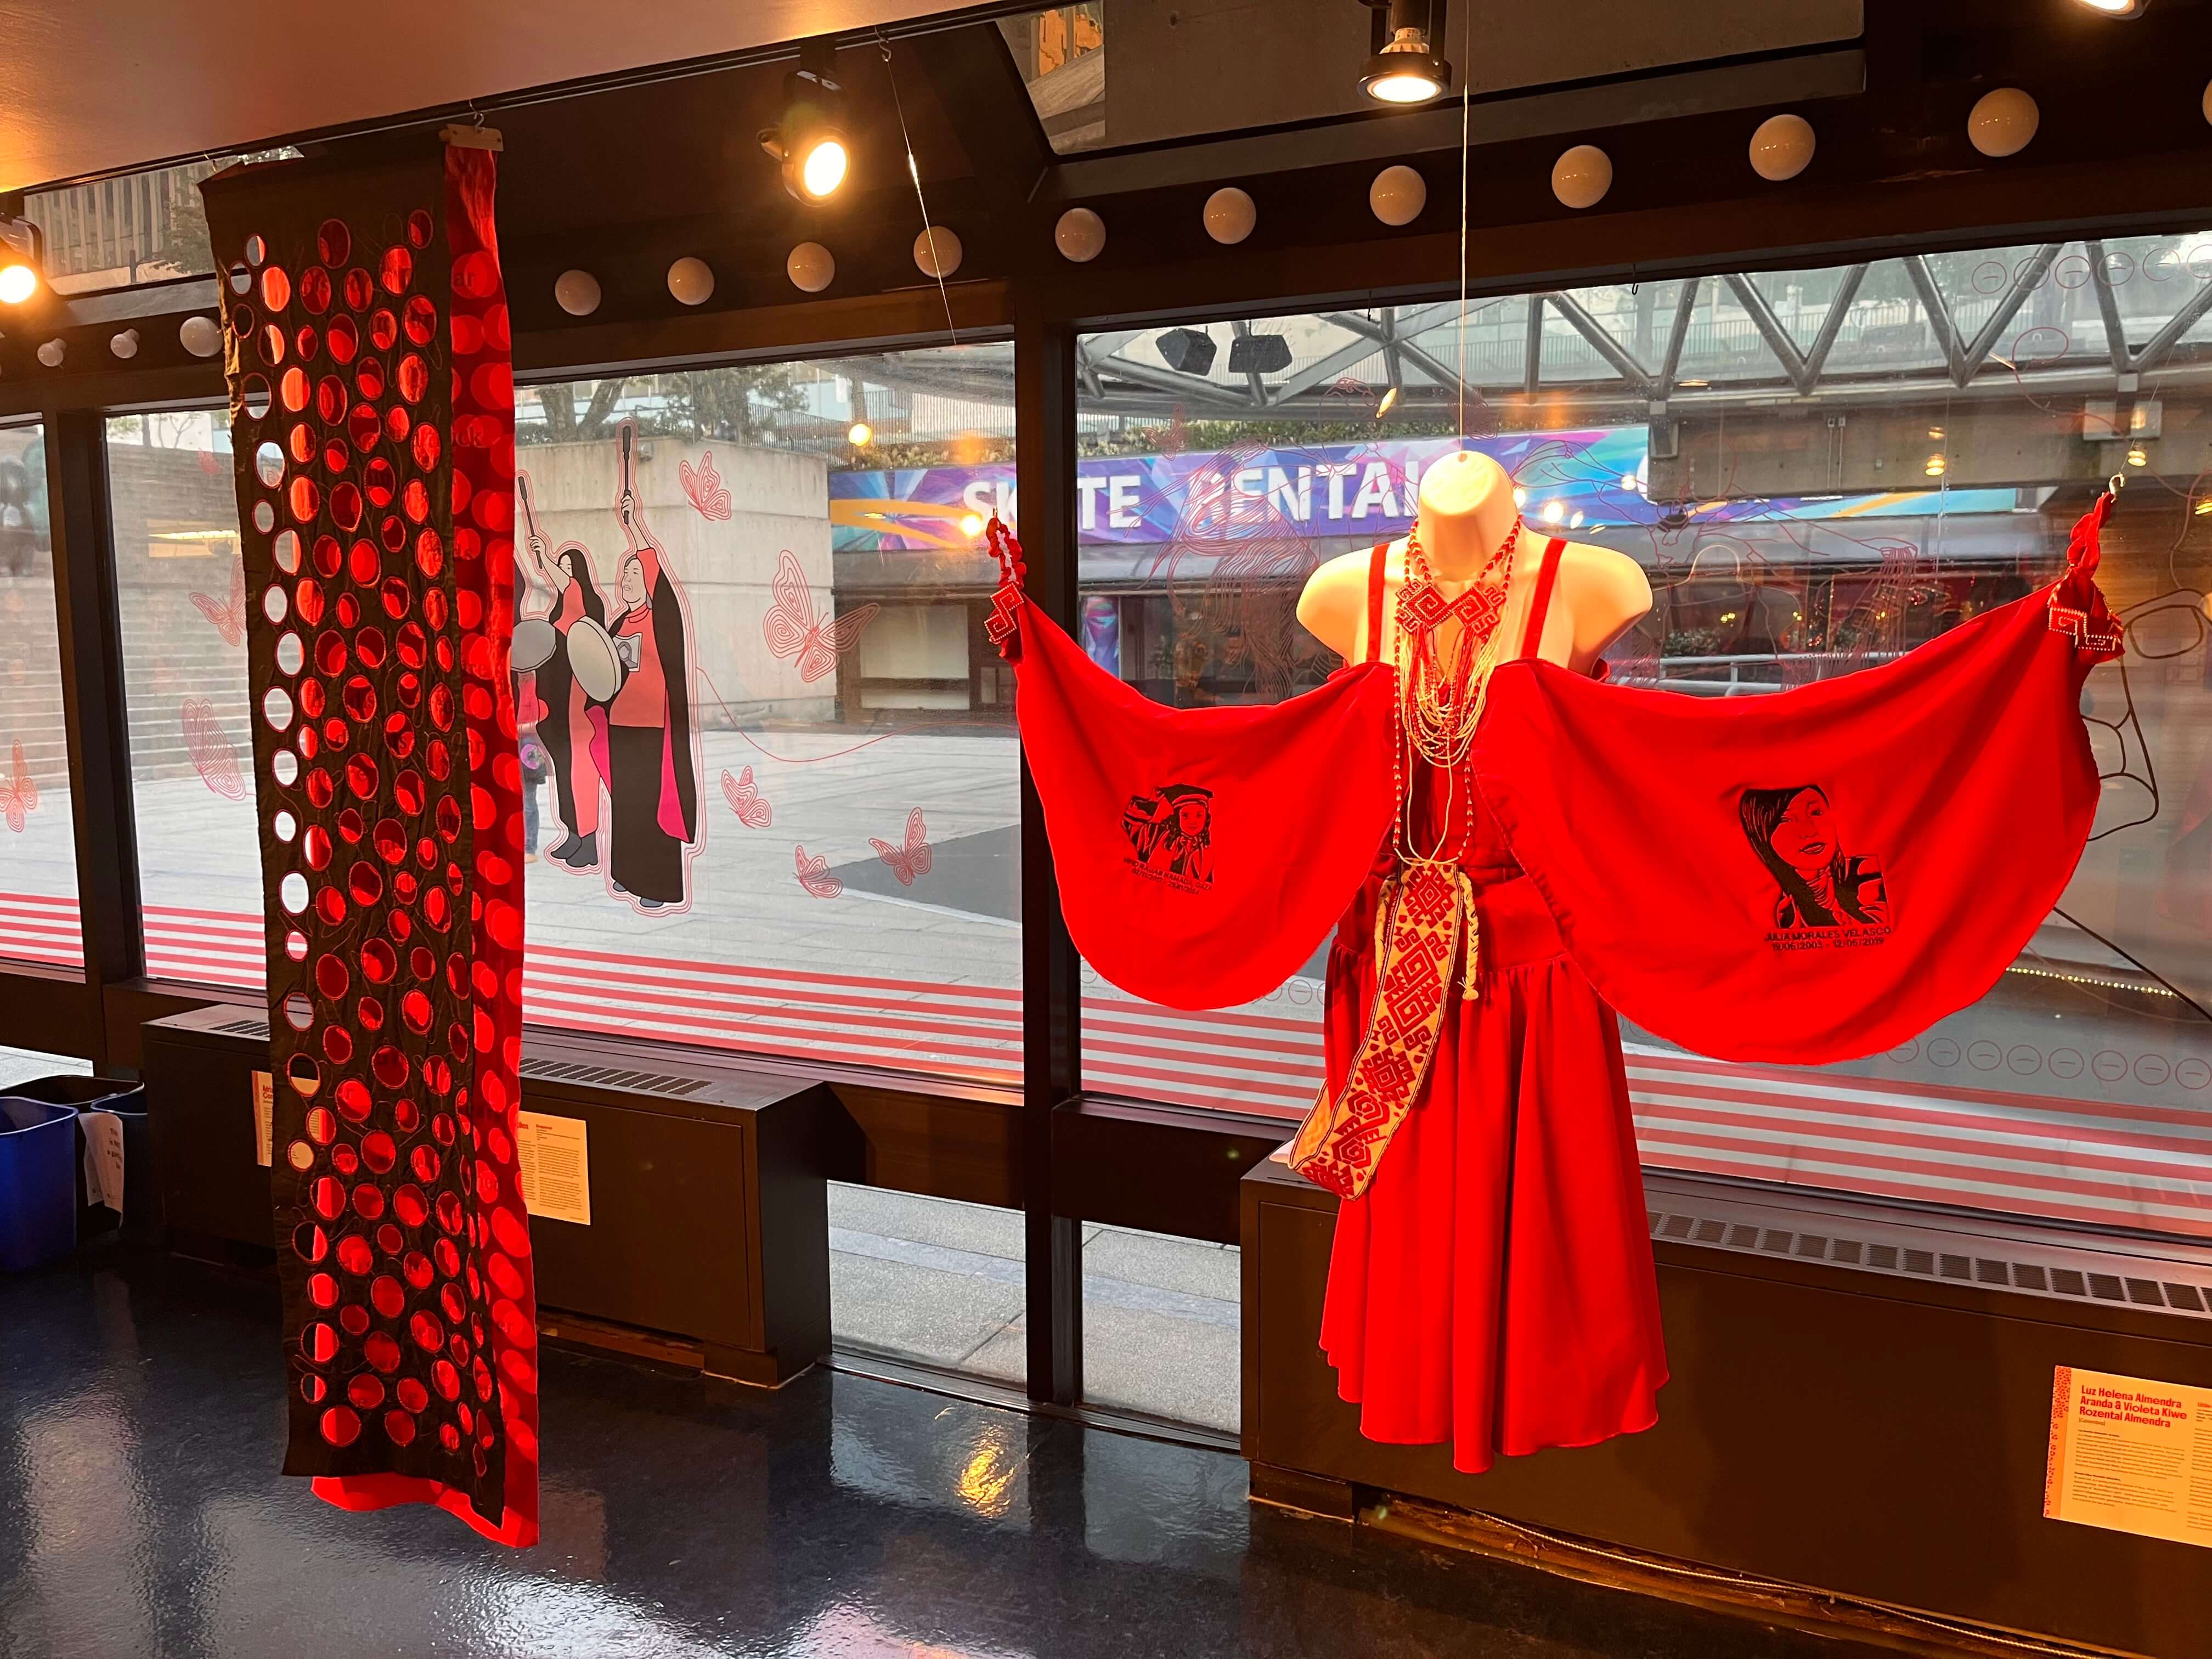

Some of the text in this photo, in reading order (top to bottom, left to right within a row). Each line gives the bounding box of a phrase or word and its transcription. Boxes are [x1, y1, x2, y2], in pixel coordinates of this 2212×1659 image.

[963, 475, 1142, 531] SKTE
[1764, 926, 1892, 941] JULIA MORALES VELASCO
[2080, 1395, 2113, 1408] Aranda
[2115, 1401, 2121, 1410] &
[2124, 1402, 2160, 1415] Violeta
[2162, 1408, 2187, 1419] Kiwe
[2081, 1385, 2096, 1396] Luz
[2098, 1387, 2133, 1401] Helena
[2135, 1393, 2182, 1408] Almendra
[2080, 1406, 2170, 1427] Rozental Almendra
